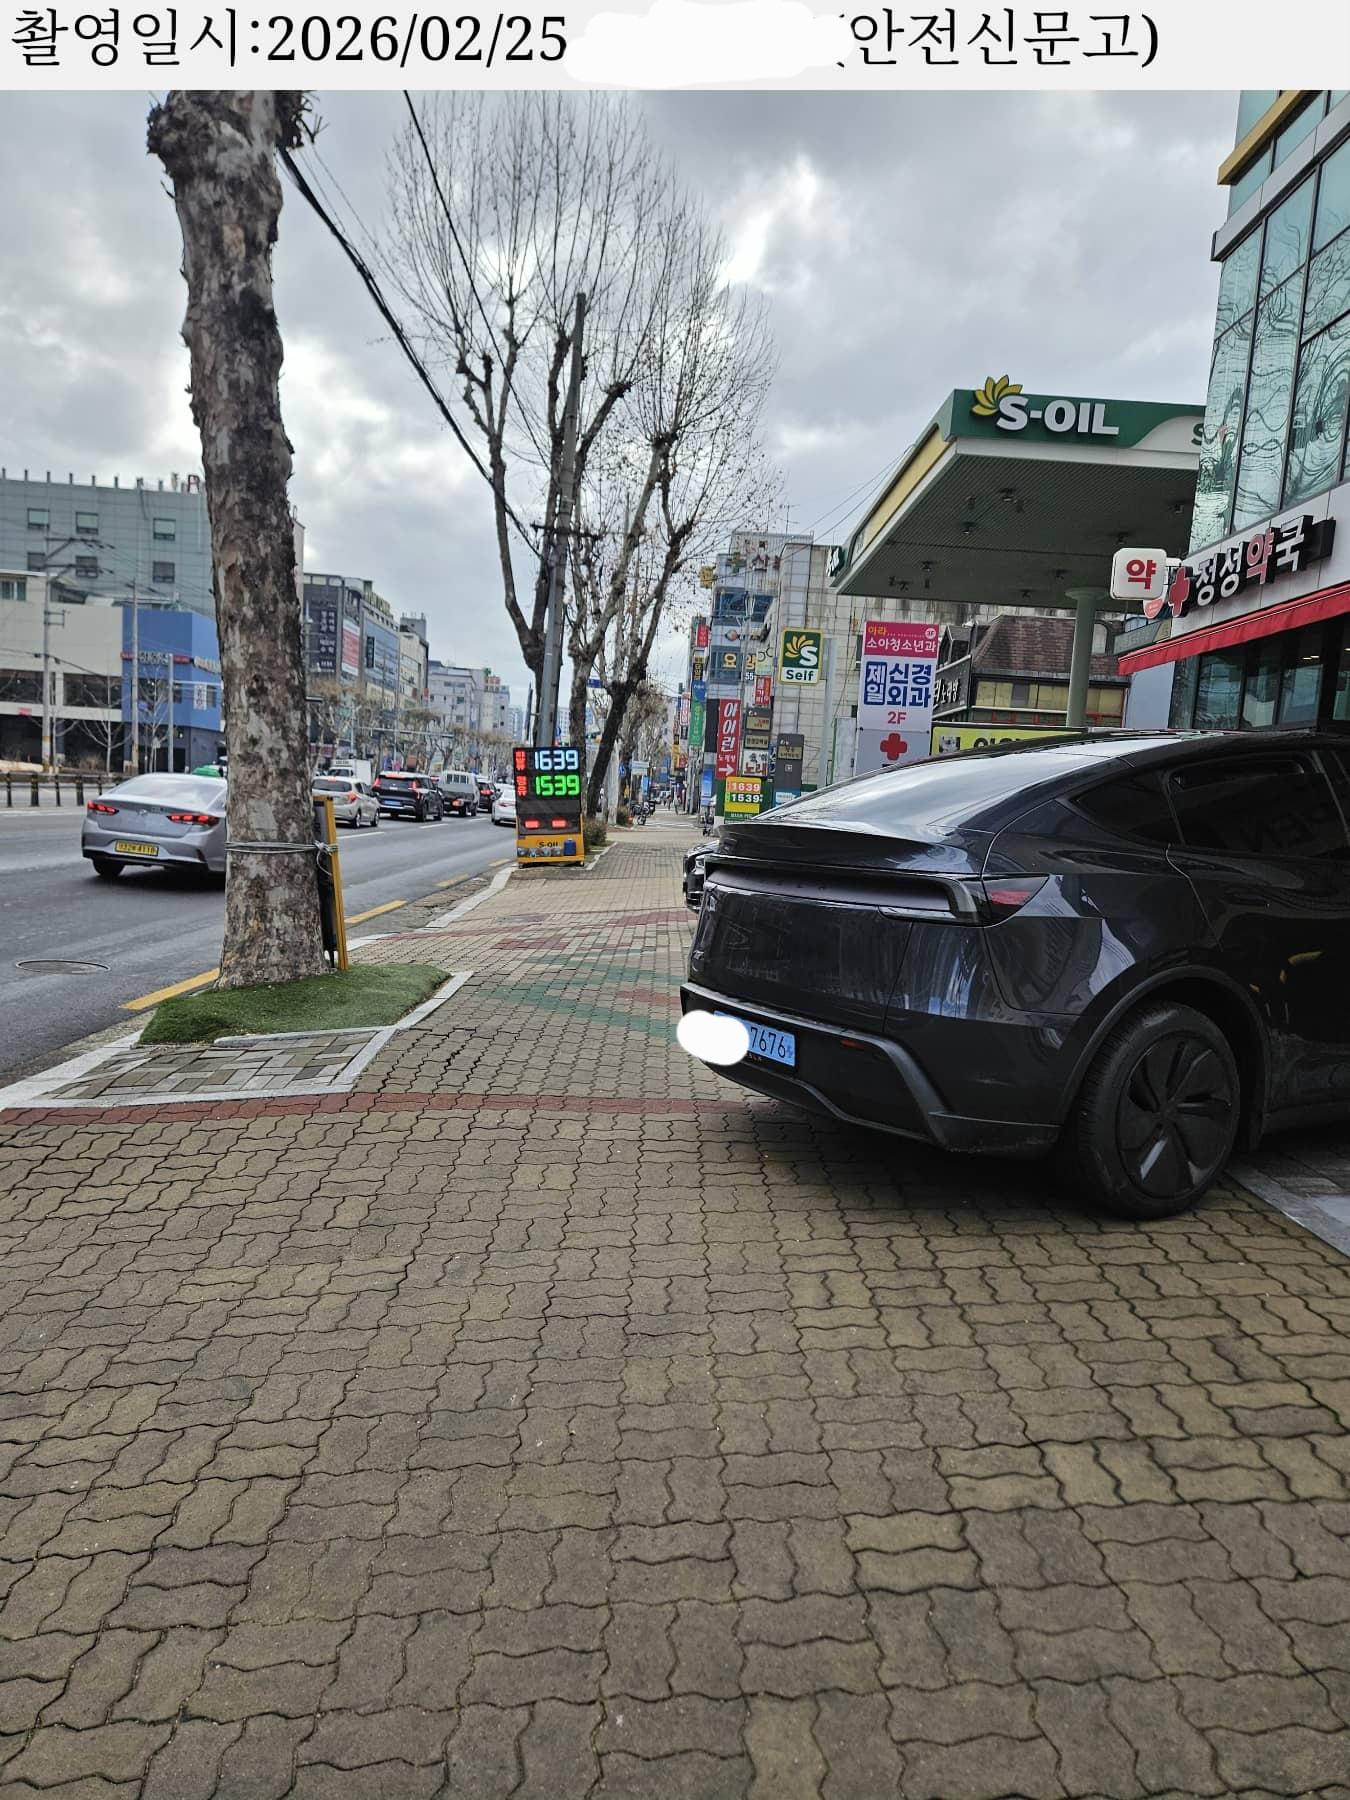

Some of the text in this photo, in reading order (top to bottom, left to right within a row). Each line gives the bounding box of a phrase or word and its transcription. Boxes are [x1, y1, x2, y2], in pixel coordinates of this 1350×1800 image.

[996, 394, 1119, 436] S-OIL
[1194, 516, 1307, 607] 정성약국
[1126, 559, 1157, 590] 약
[866, 637, 937, 653] 소아청소년과
[799, 646, 818, 667] S
[786, 669, 814, 682] Self
[867, 664, 885, 703] 제일
[889, 663, 932, 686] 신경
[886, 685, 931, 708] 외과
[887, 711, 907, 725] 2F
[534, 750, 579, 770] 1639
[535, 774, 580, 796] 1539
[731, 782, 760, 791] 1639
[731, 793, 760, 802] 1539
[750, 1027, 786, 1058] 7676
